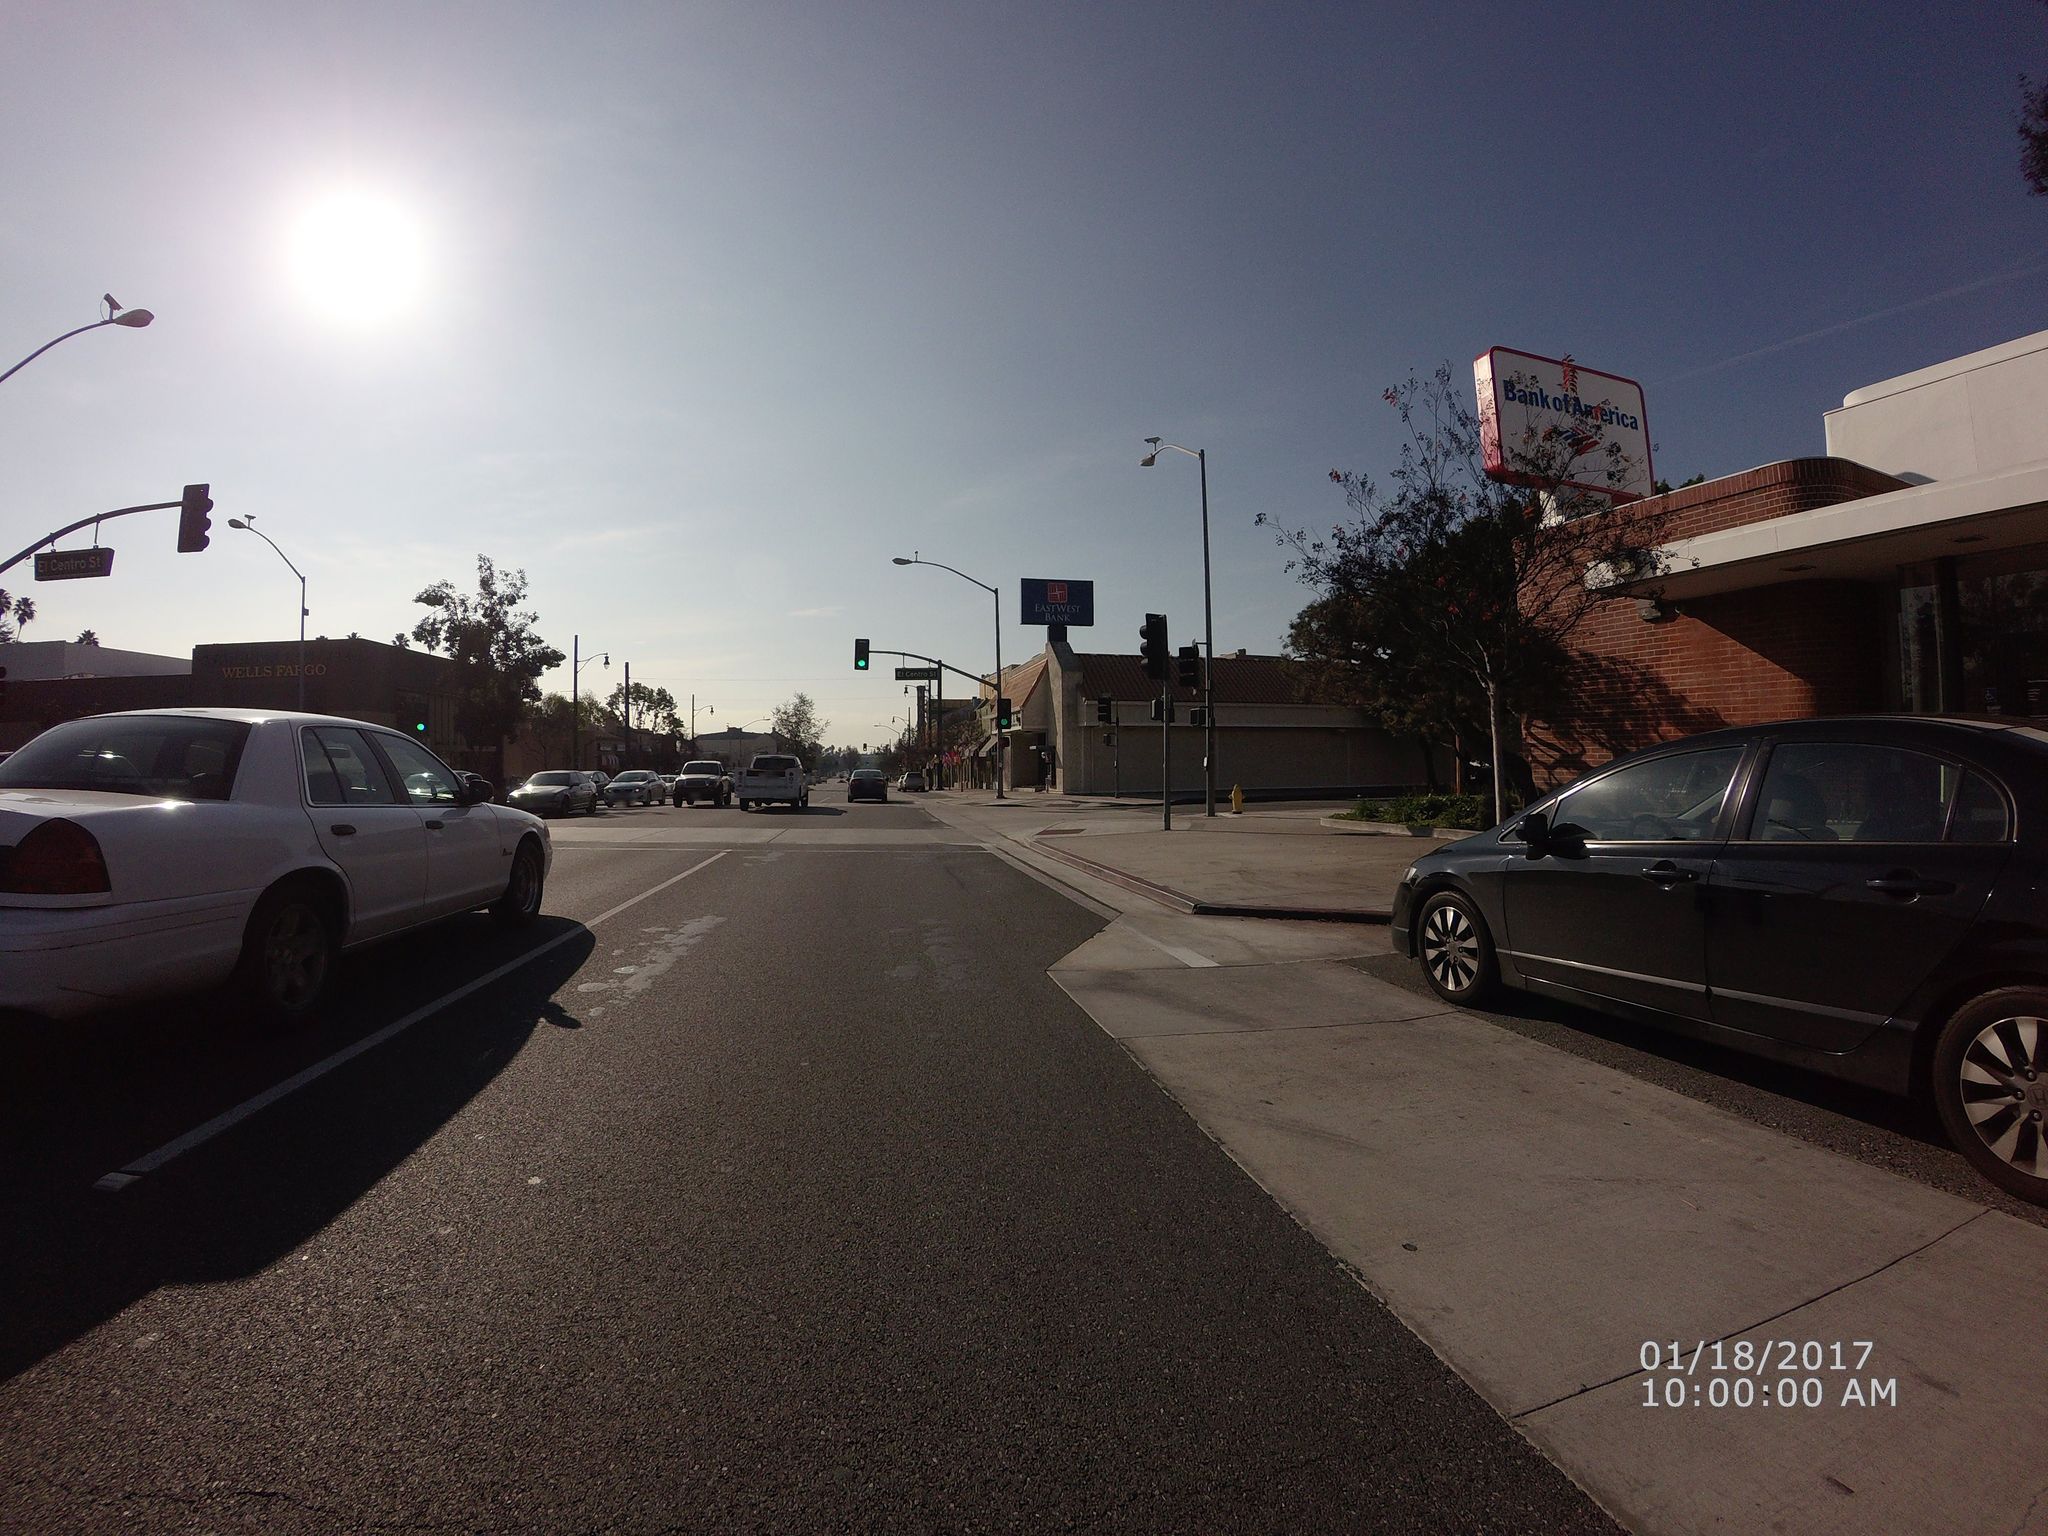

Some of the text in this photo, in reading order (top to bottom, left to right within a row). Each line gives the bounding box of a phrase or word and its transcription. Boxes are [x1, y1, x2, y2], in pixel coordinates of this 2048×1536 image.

[1503, 379, 1551, 410] Bank
[1552, 393, 1570, 413] of
[38, 555, 100, 573] El Centro St
[223, 665, 272, 679] WELLS
